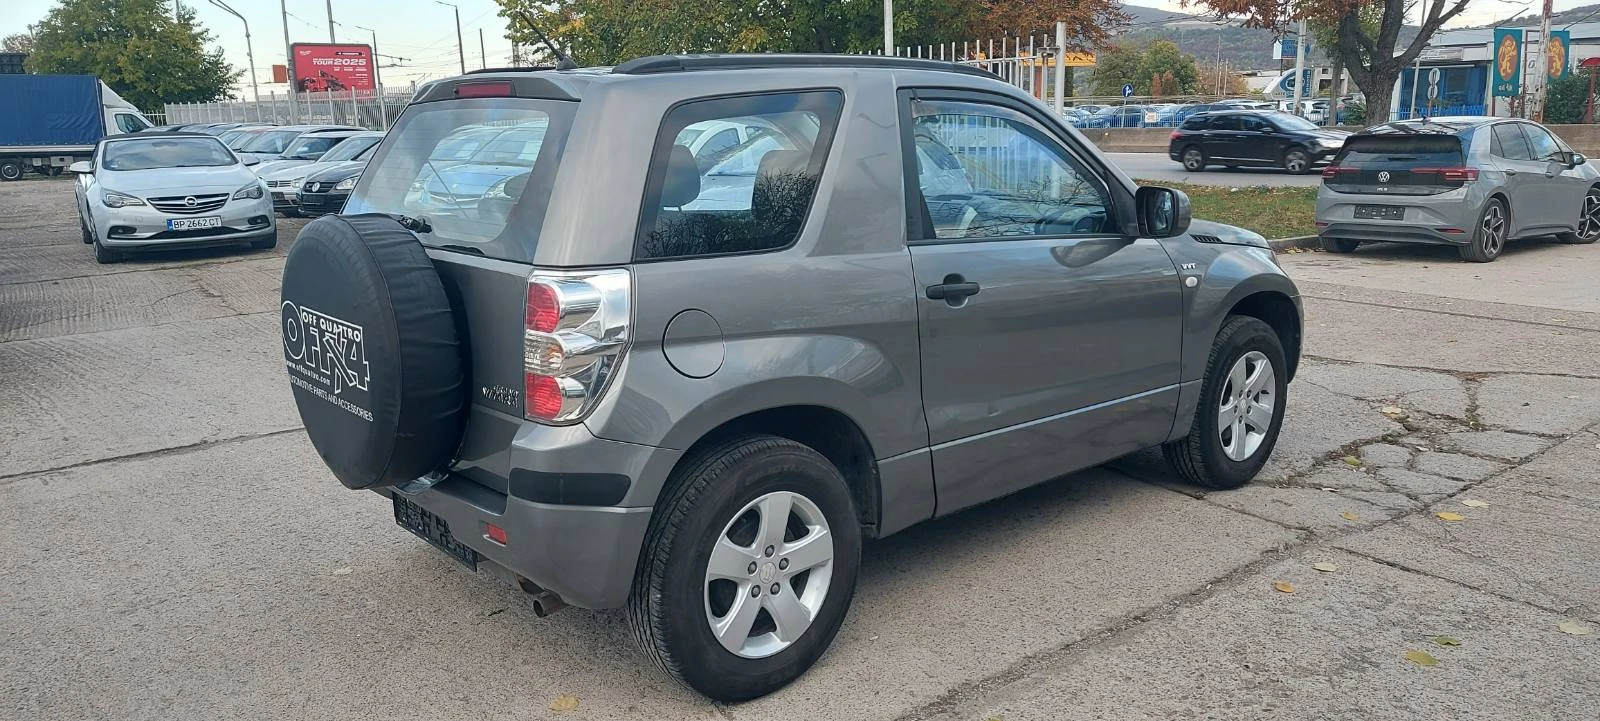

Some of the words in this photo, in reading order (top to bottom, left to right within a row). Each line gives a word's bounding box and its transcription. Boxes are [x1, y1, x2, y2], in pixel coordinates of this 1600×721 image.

[333, 58, 367, 66] 2025
[173, 220, 185, 229] BP
[187, 218, 208, 228] 2662
[302, 311, 317, 325] OFF
[319, 318, 361, 342] QUATTRO
[313, 386, 328, 401] PARTS
[328, 393, 338, 405] AND
[337, 398, 374, 422] ACCESSORIES
